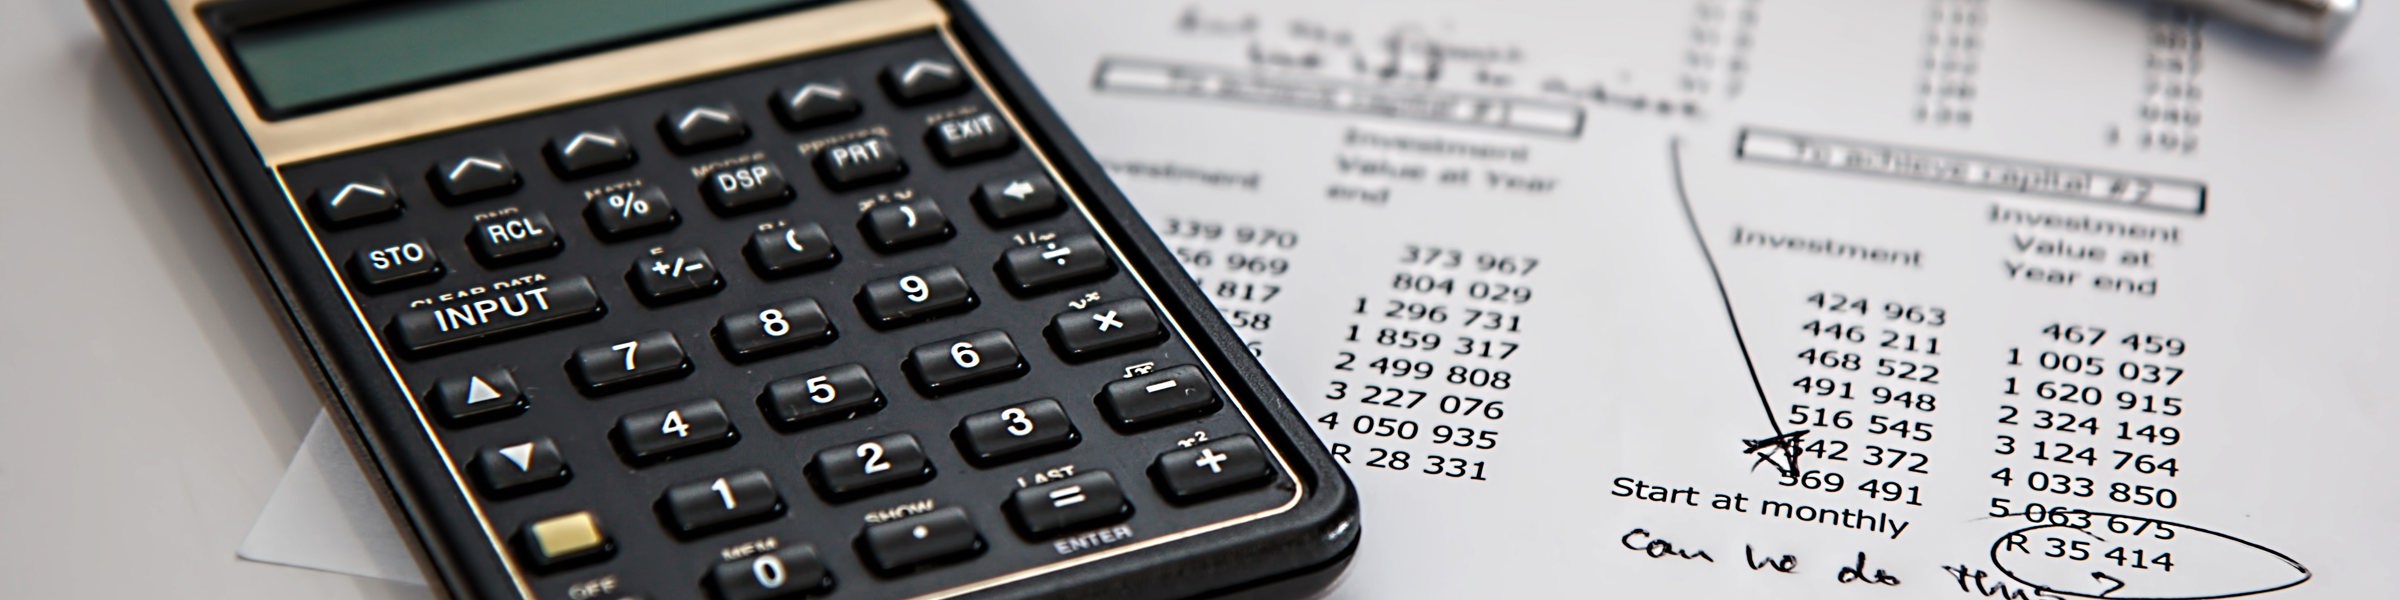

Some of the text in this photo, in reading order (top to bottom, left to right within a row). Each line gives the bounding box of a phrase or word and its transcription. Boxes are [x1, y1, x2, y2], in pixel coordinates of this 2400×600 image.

[941, 114, 996, 141] EXIT
[833, 140, 882, 166] PRT
[717, 165, 769, 193] DSP
[487, 217, 543, 245] RCL
[1165, 217, 1298, 249] 339 970
[1988, 203, 2183, 244] Investment
[369, 242, 424, 271] STO
[1227, 253, 1289, 275] 969
[1403, 245, 1541, 277] 373 967
[1733, 226, 1926, 268] Investment
[2012, 233, 2155, 269] Value at
[900, 275, 929, 302] 9
[1217, 280, 1280, 304] 817
[1393, 272, 1533, 305] 804 029
[2004, 260, 2159, 298] Year end
[434, 288, 549, 332] INPUT
[759, 307, 790, 337] 8
[1353, 297, 1522, 333] 1 296 731
[1806, 292, 1946, 328] 424 963
[950, 341, 981, 369] 6
[1345, 324, 1519, 361] 1 859 317
[1802, 320, 1941, 356] 446 211
[2042, 323, 2186, 358] 467 459
[611, 340, 639, 372] 7
[1335, 352, 1512, 391] 2 499 808
[1797, 348, 1940, 384] 468 522
[2008, 347, 2184, 387] 1 005 037
[806, 375, 836, 404] 5
[1325, 381, 1505, 420] 3 227 076
[1792, 376, 1936, 412] 491 948
[2004, 377, 2182, 417] 1 620 915
[661, 409, 689, 438] 4
[1001, 407, 1034, 436] 3
[1317, 411, 1499, 450] 4 050 935
[1788, 404, 1933, 442] 516 545
[1998, 405, 2180, 446] 2 324 149
[856, 441, 892, 475] 2
[1331, 443, 1488, 481] R 28 331
[1863, 444, 1929, 474] 372
[1994, 435, 2179, 478] 3 124 764
[1016, 464, 1075, 487] AST
[1858, 478, 1923, 506] 491
[1990, 467, 2177, 509] 4 033 850
[710, 477, 737, 510] 1
[1611, 476, 1909, 540] Start at monthly
[1988, 497, 2175, 541] 5 063 675
[1053, 525, 1134, 556] ENTER
[2005, 531, 2175, 572] R 35 414
[752, 554, 787, 589] 0
